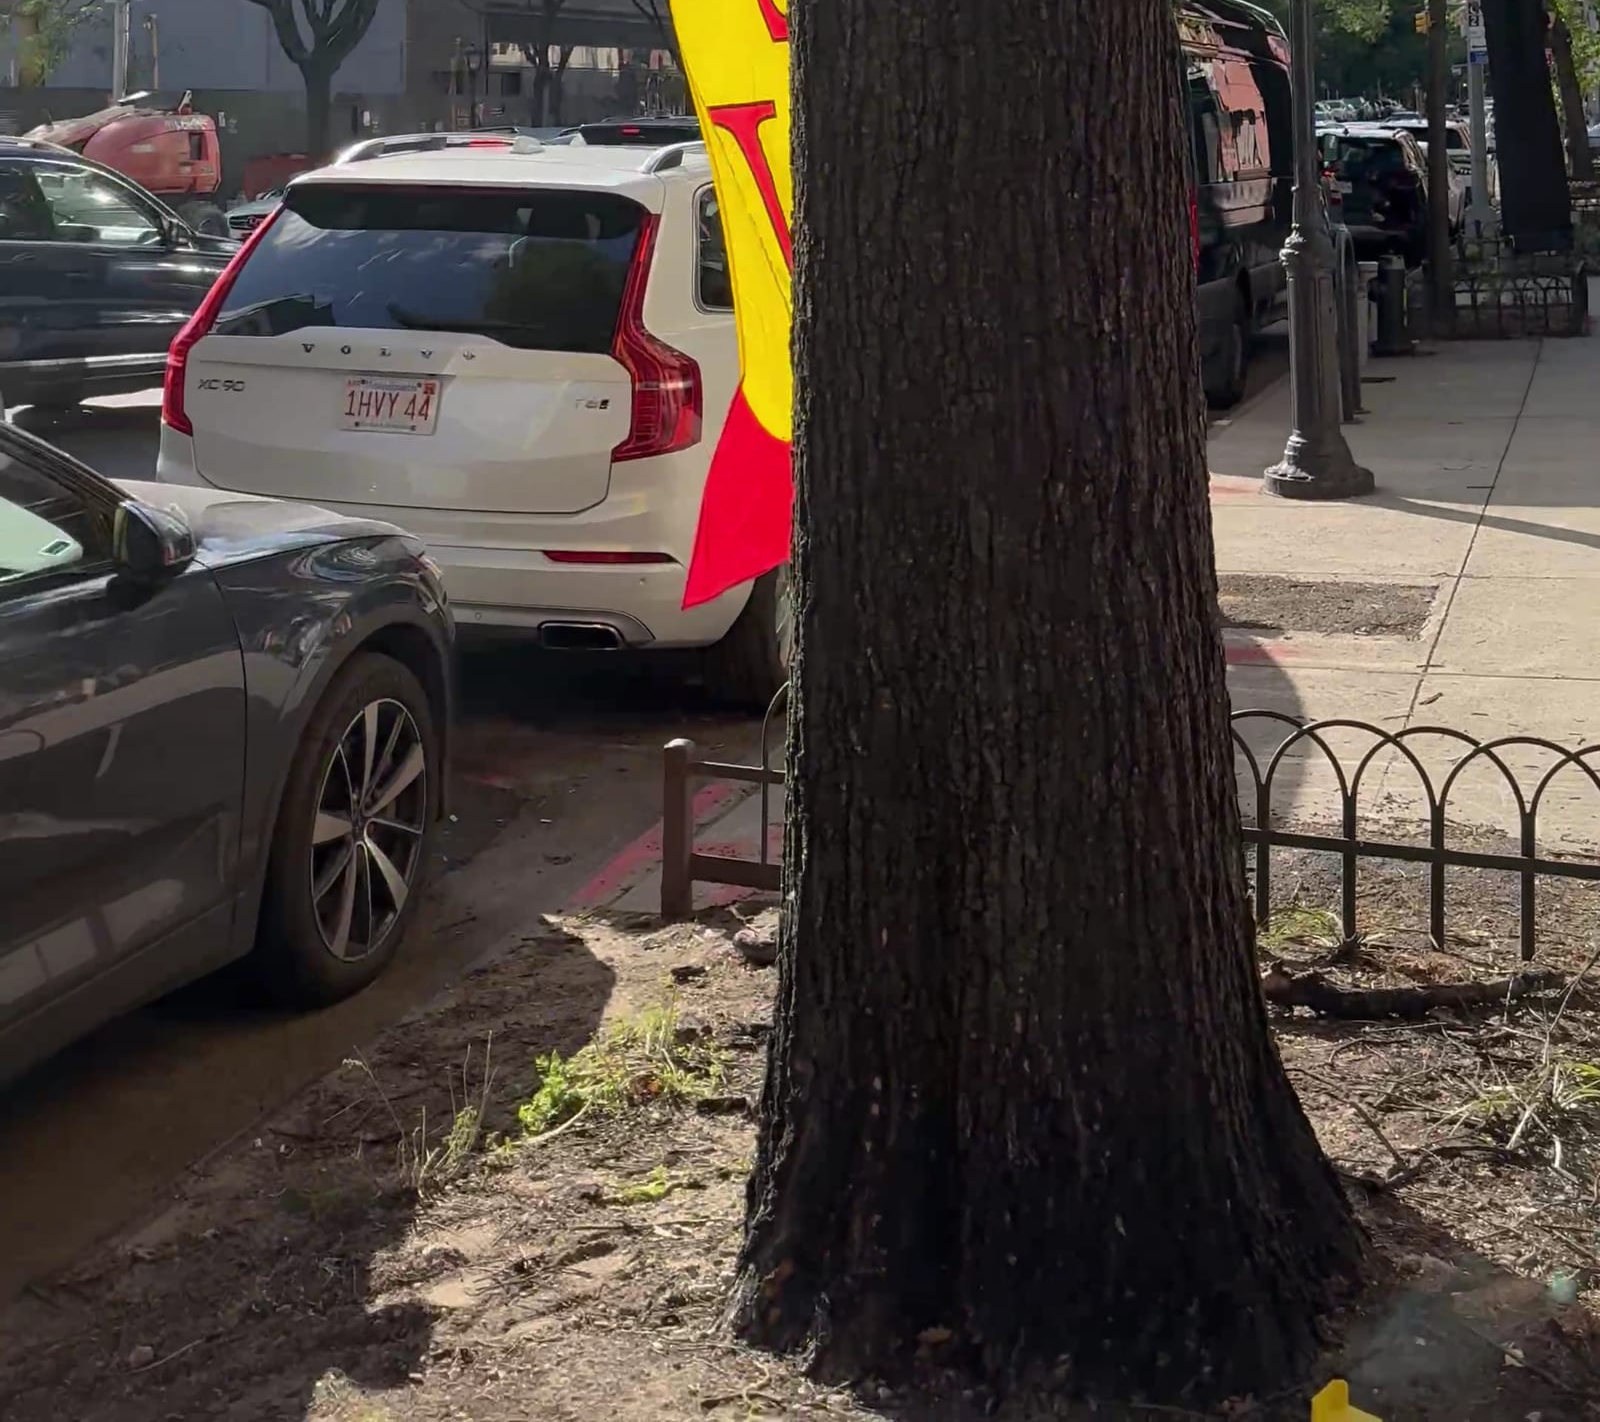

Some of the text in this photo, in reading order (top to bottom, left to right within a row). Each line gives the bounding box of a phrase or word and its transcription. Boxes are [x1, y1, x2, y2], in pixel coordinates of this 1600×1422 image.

[302, 343, 476, 360] VOLVO
[344, 390, 431, 420] 1HVY 44
